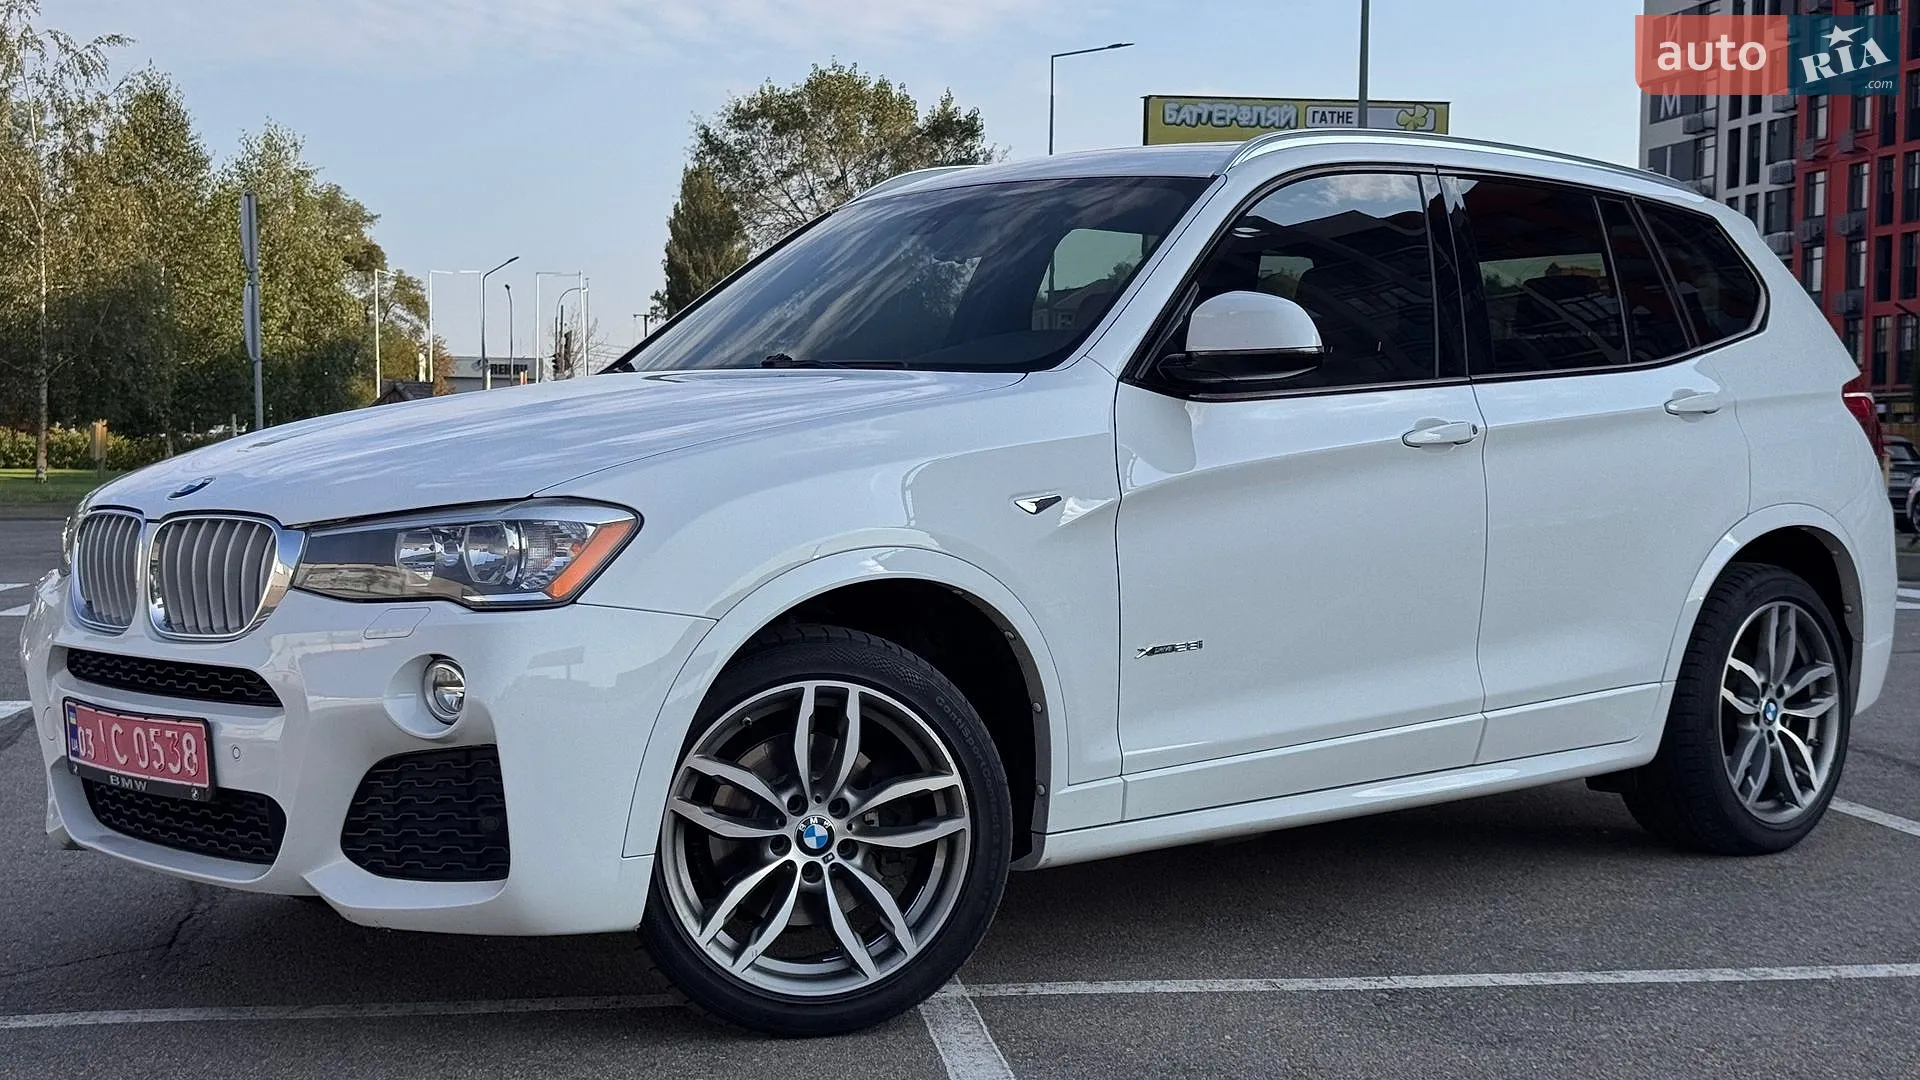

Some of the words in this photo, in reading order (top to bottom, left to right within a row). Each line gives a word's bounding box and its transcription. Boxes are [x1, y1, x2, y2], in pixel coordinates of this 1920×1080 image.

[1162, 102, 1298, 129] БАТТЕРФЛЯЙ
[1311, 109, 1354, 125] ГАТНЕ
[77, 726, 96, 760] 03
[133, 727, 200, 776] 0538
[109, 775, 149, 792] BMW
